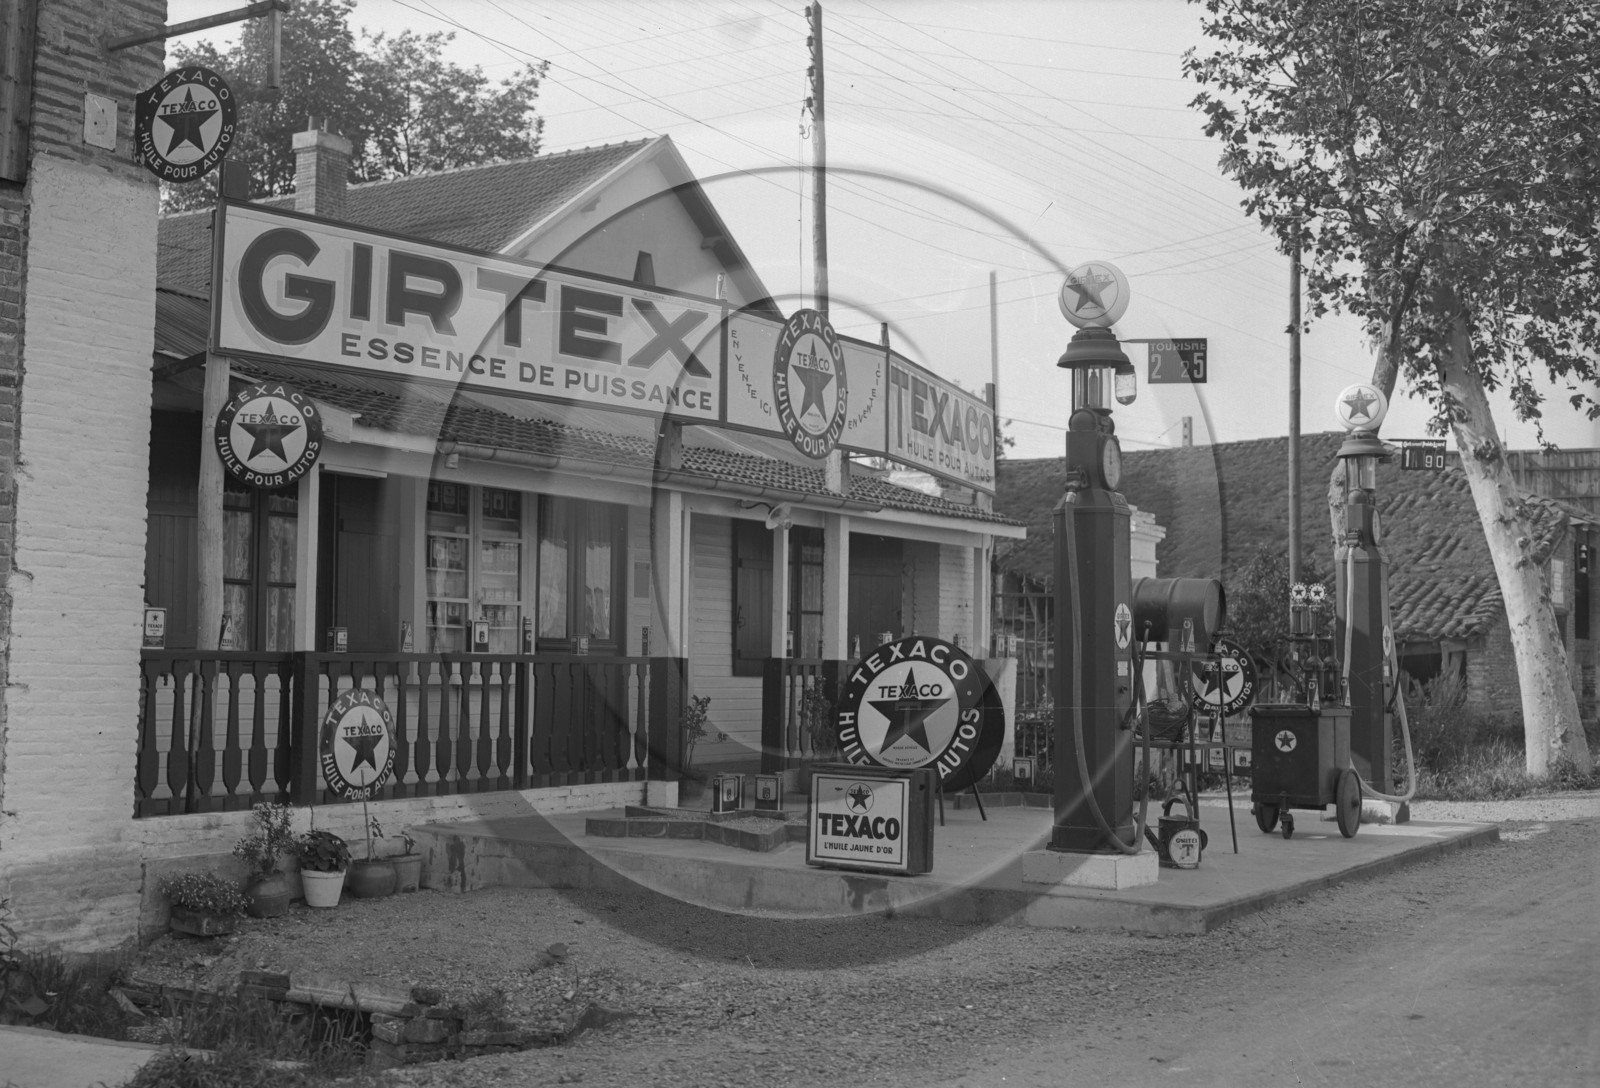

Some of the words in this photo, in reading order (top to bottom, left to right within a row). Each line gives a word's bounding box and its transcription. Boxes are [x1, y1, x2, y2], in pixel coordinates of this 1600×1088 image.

[149, 70, 229, 105] TEXACO
[162, 99, 217, 115] TEXACO
[141, 132, 163, 170] HUILE
[164, 166, 197, 178] POUR
[203, 124, 233, 170] AUTOS
[238, 227, 712, 379] GIRTEX
[781, 313, 841, 361] TEXACO
[1150, 342, 1206, 351] TOURISME
[341, 332, 506, 379] ESSENCE
[519, 362, 554, 386] DE
[565, 369, 712, 411] PUISSANCE
[731, 330, 739, 348] EN
[735, 354, 757, 399] VENTE
[760, 400, 772, 416] ICI
[797, 352, 830, 372] TEXACO
[225, 385, 314, 417] TEXACO
[240, 413, 300, 425] TEXACO
[776, 372, 796, 434] HUILE
[795, 429, 826, 455] POUR
[827, 387, 846, 448] AUTOS
[848, 420, 857, 430] EN
[858, 389, 876, 423] VENTE
[891, 365, 993, 460] TEXACO
[218, 436, 243, 475] HUILE
[245, 472, 284, 486] POUR
[288, 441, 318, 481] AUTOS
[907, 433, 934, 462] HUILE
[939, 451, 961, 473] POUR
[965, 462, 991, 482] AUTOS
[851, 640, 969, 686] TEXACO
[326, 692, 390, 725] TEXACO
[878, 684, 943, 698] TEXACO
[1232, 681, 1253, 710] AUTOS
[343, 725, 382, 736] TEXACO
[839, 712, 871, 766] HUILE
[936, 708, 980, 779] AUTOS
[322, 753, 345, 793] HUILE
[344, 787, 371, 800] POUR
[375, 749, 395, 792] AUTOS
[818, 812, 900, 841] TEXACO
[824, 842, 848, 851] L'HUILE
[850, 844, 874, 853] JAUNE
[876, 846, 893, 854] D'OR
